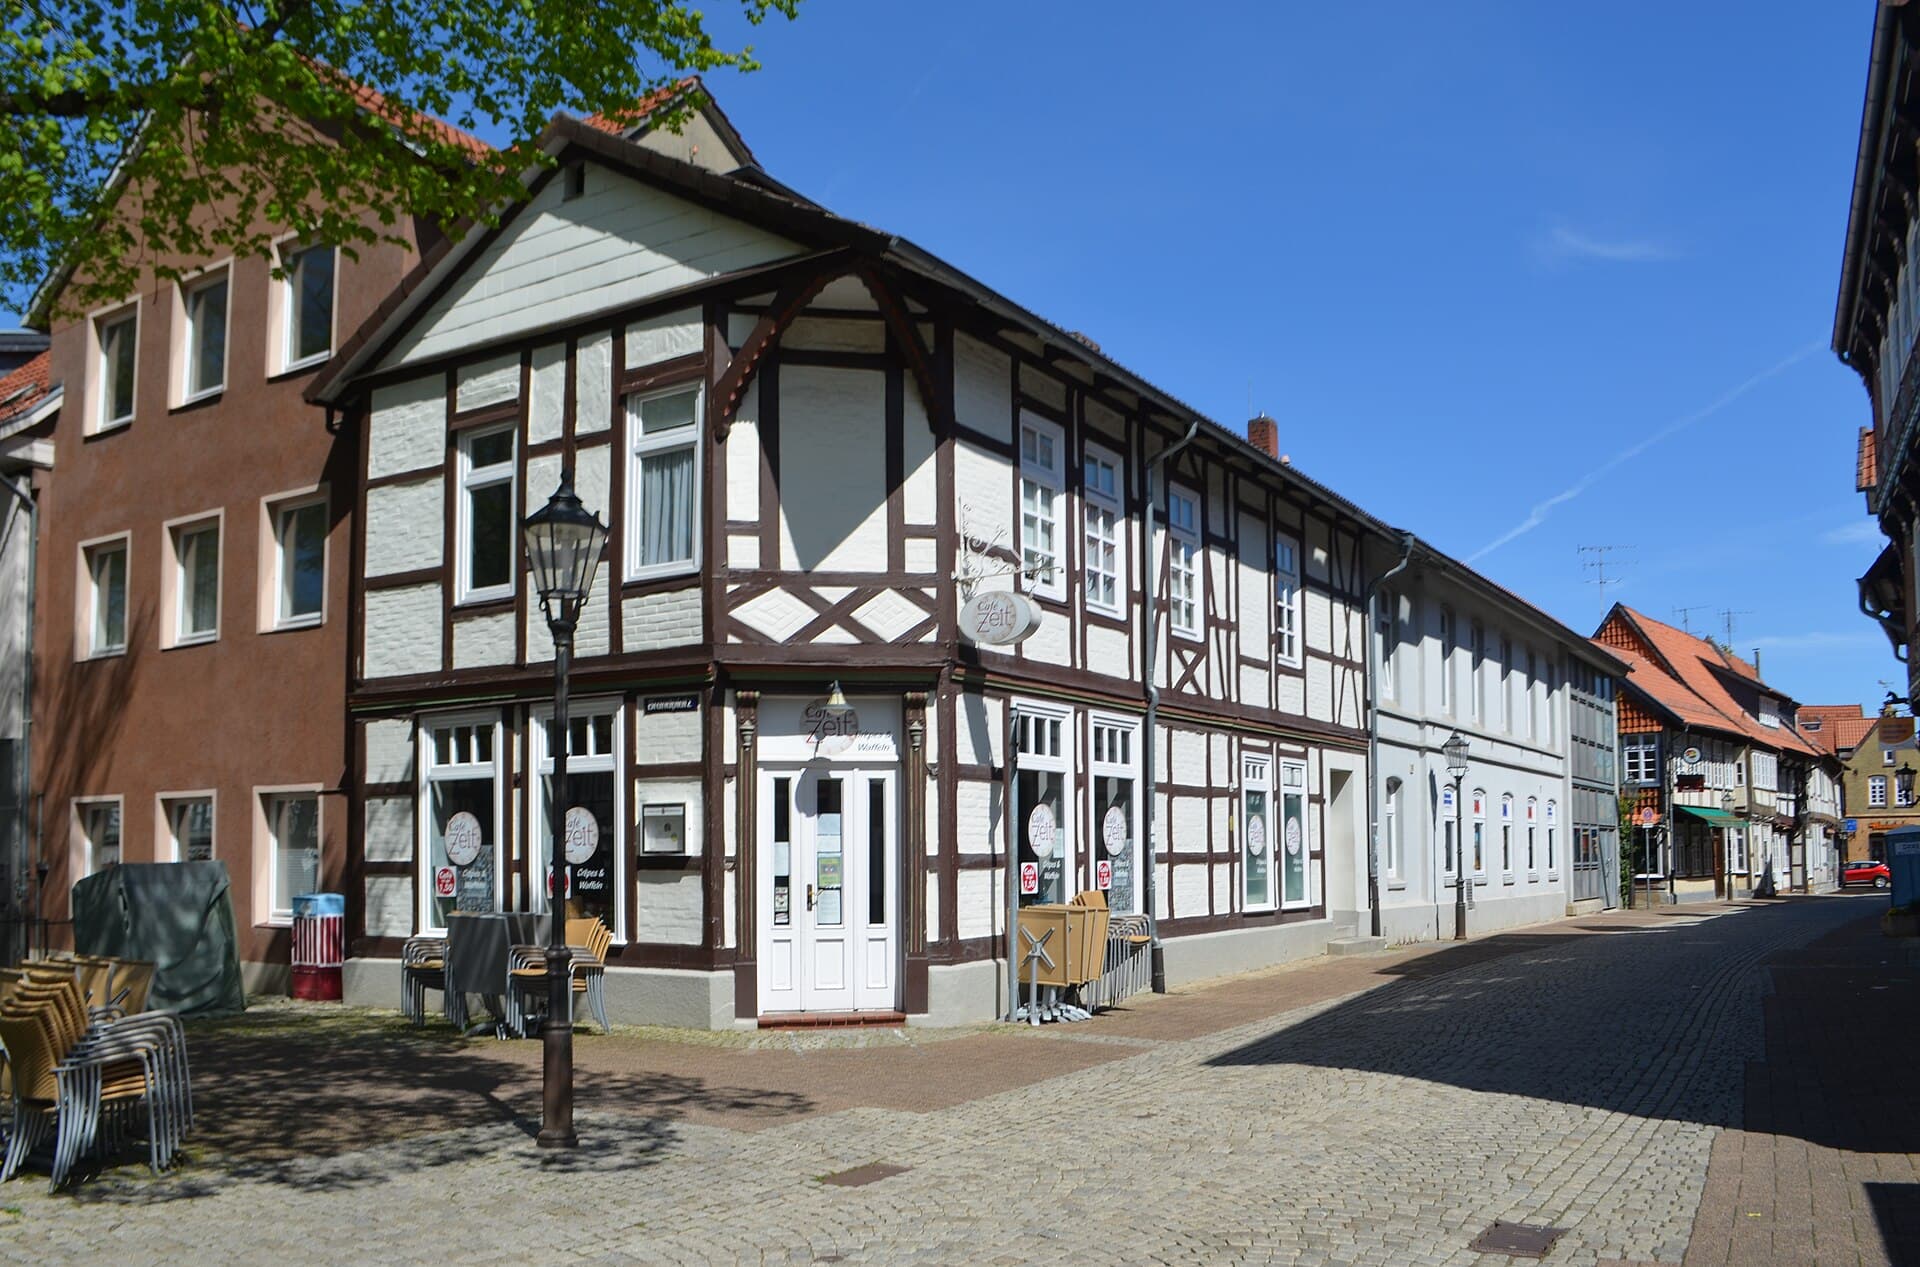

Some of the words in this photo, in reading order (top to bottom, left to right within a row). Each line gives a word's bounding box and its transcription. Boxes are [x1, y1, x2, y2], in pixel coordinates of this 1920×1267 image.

[976, 600, 999, 612] Café
[976, 605, 1012, 633] Zeit
[806, 709, 853, 743] Zeit
[448, 829, 477, 855] Zeit
